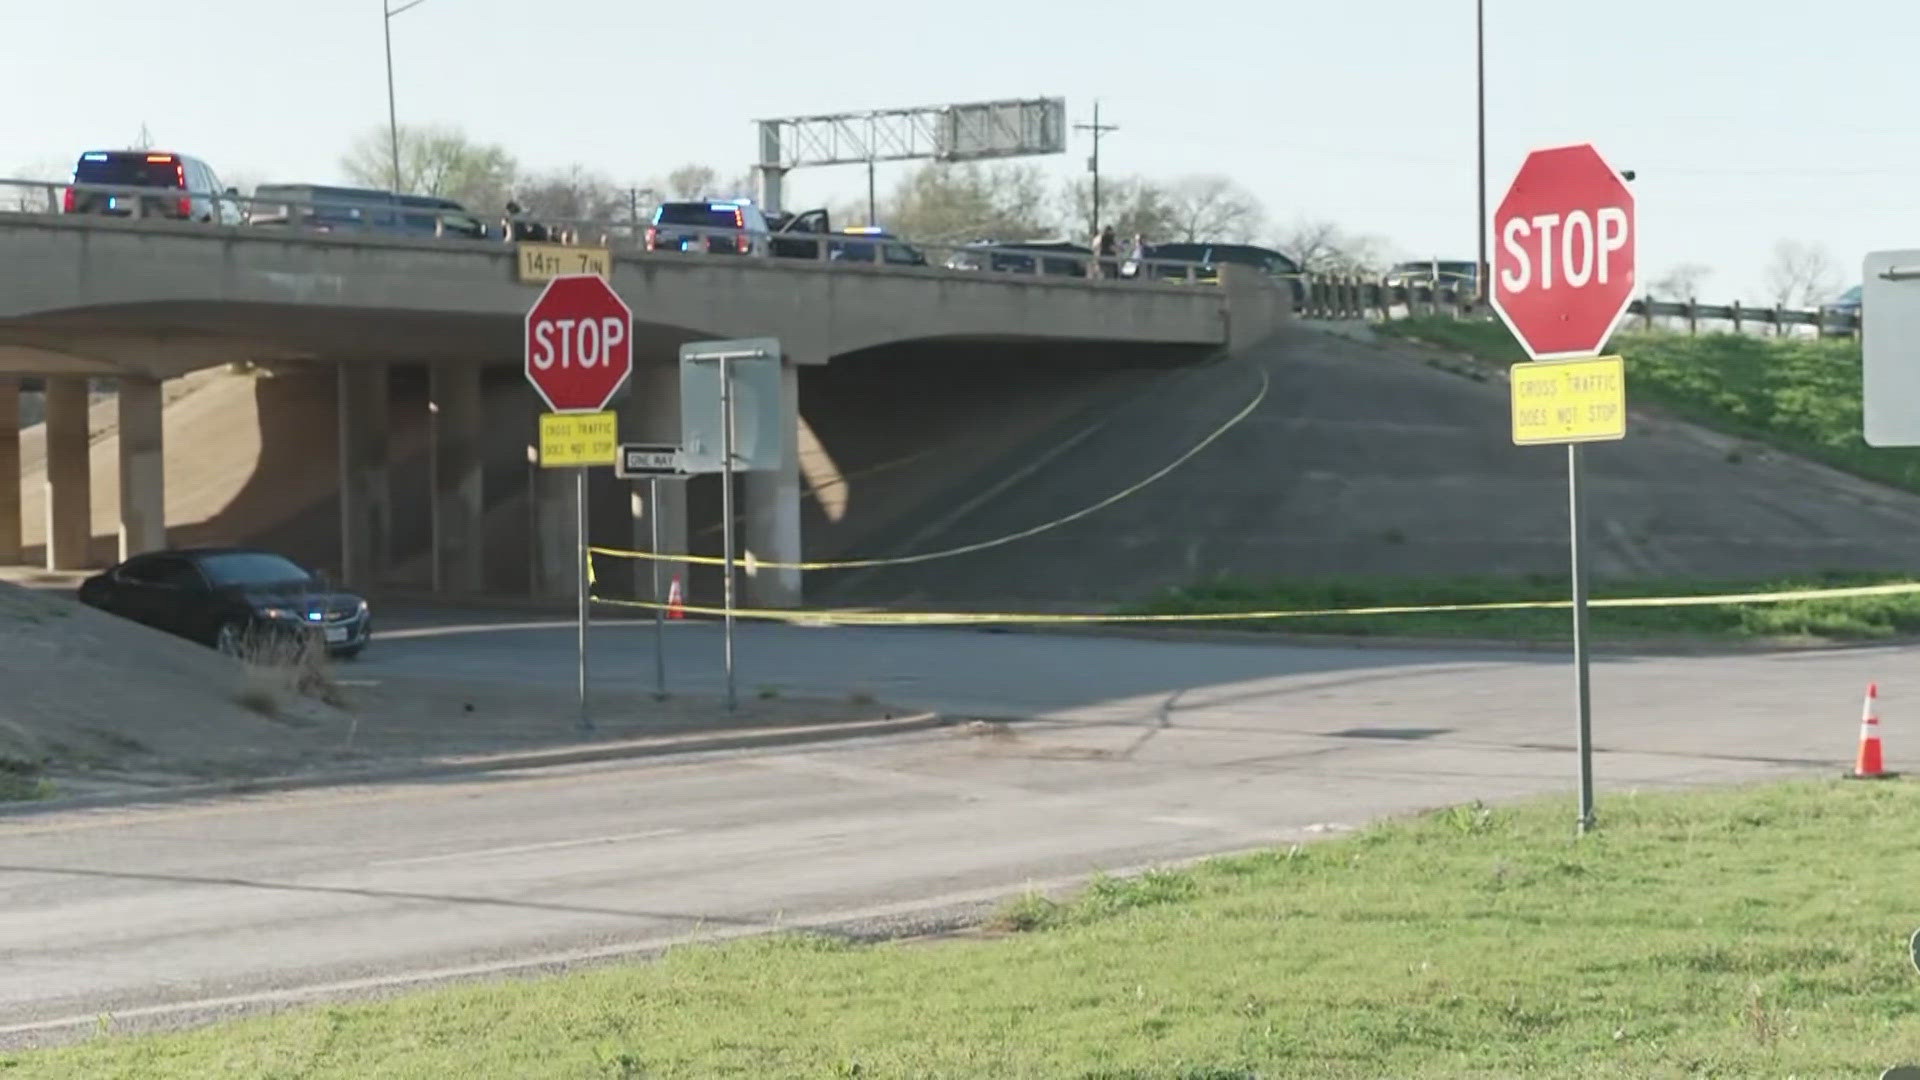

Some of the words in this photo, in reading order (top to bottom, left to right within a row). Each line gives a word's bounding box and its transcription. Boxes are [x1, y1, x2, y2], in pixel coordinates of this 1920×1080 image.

[1501, 208, 1628, 293] STOP
[534, 318, 624, 370] STOP
[1519, 378, 1558, 397] CROSS
[1567, 374, 1617, 393] TRAFFIC
[1519, 409, 1548, 427] DOES
[1557, 406, 1578, 424] NOT
[1589, 403, 1617, 422] STOP
[577, 422, 612, 434] TRAFFIC
[570, 442, 585, 453] NOT
[593, 441, 612, 453] STOP
[630, 455, 649, 467] ONE
[654, 455, 674, 467] WAY
